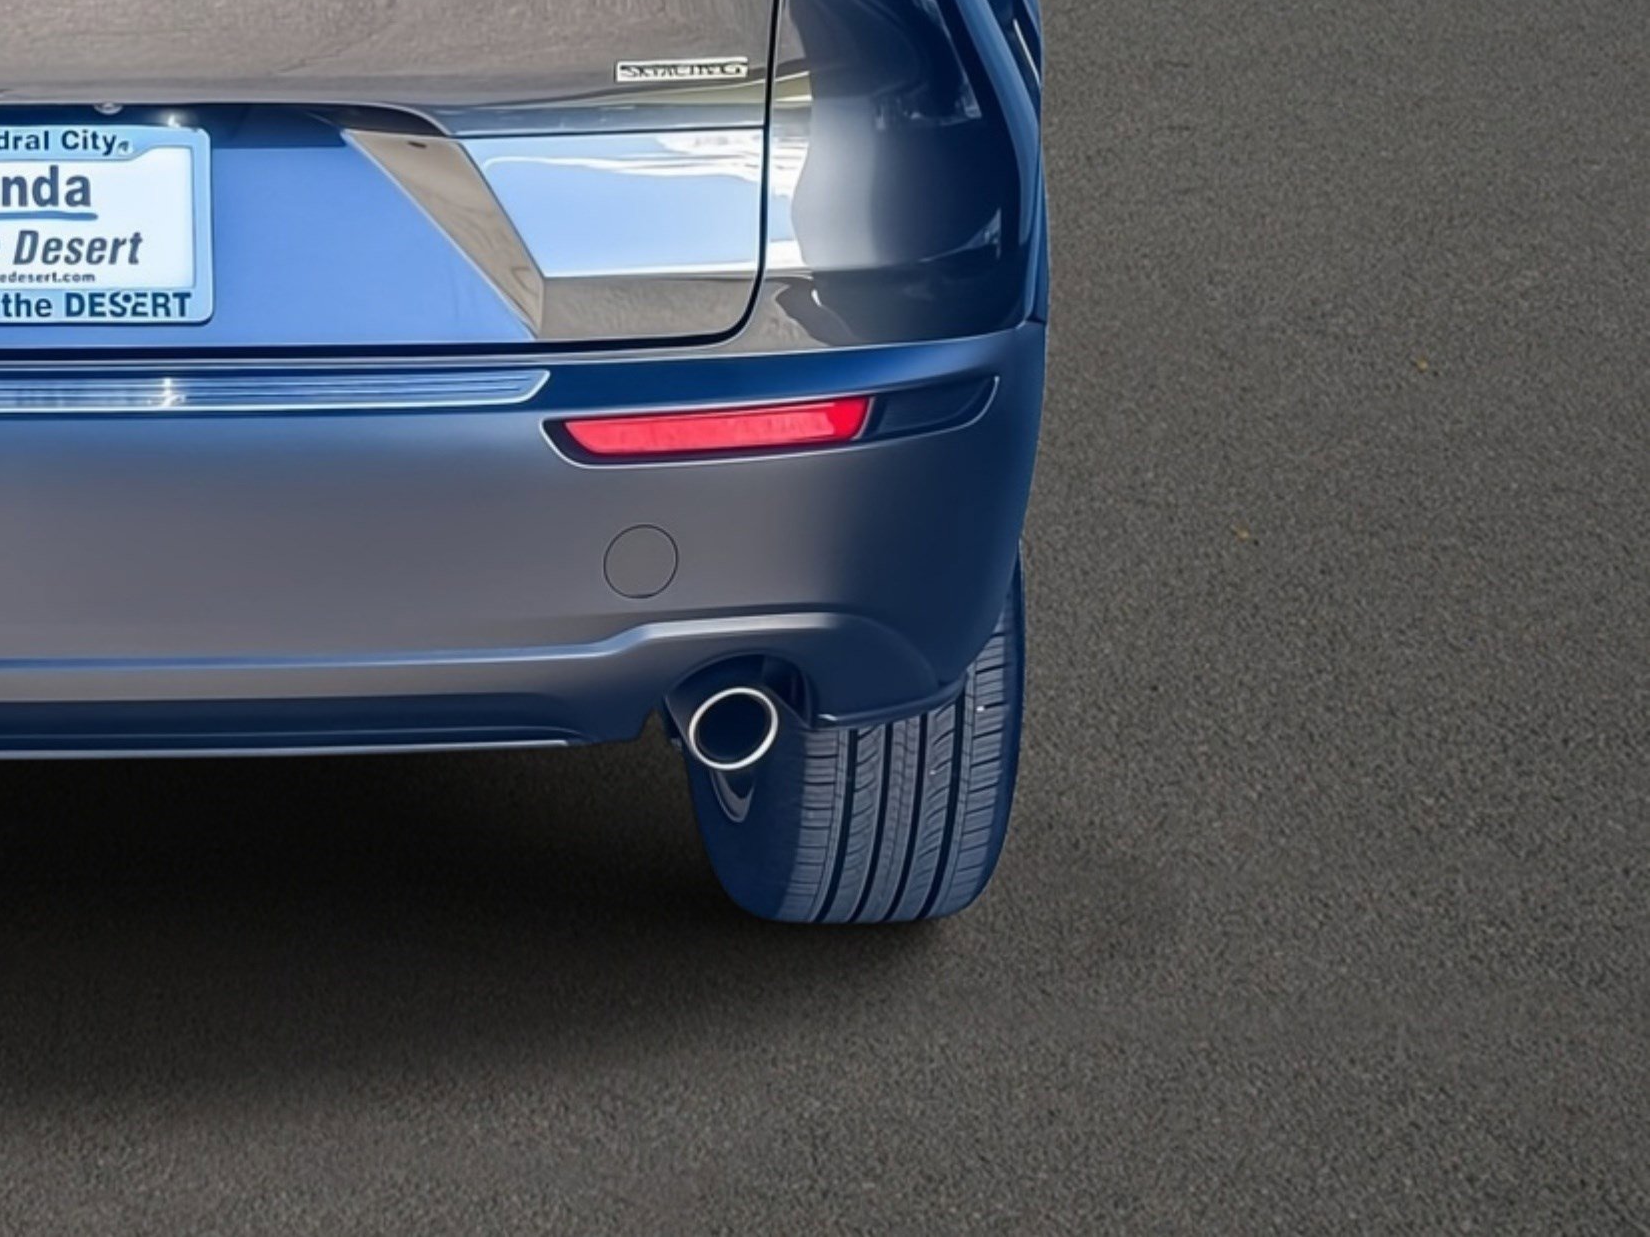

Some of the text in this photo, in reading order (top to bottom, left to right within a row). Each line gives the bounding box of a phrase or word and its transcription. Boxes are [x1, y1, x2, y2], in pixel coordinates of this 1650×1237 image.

[60, 129, 118, 156] City
[13, 229, 144, 266] Desert
[1, 292, 54, 319] the
[64, 290, 193, 319] DESERT
